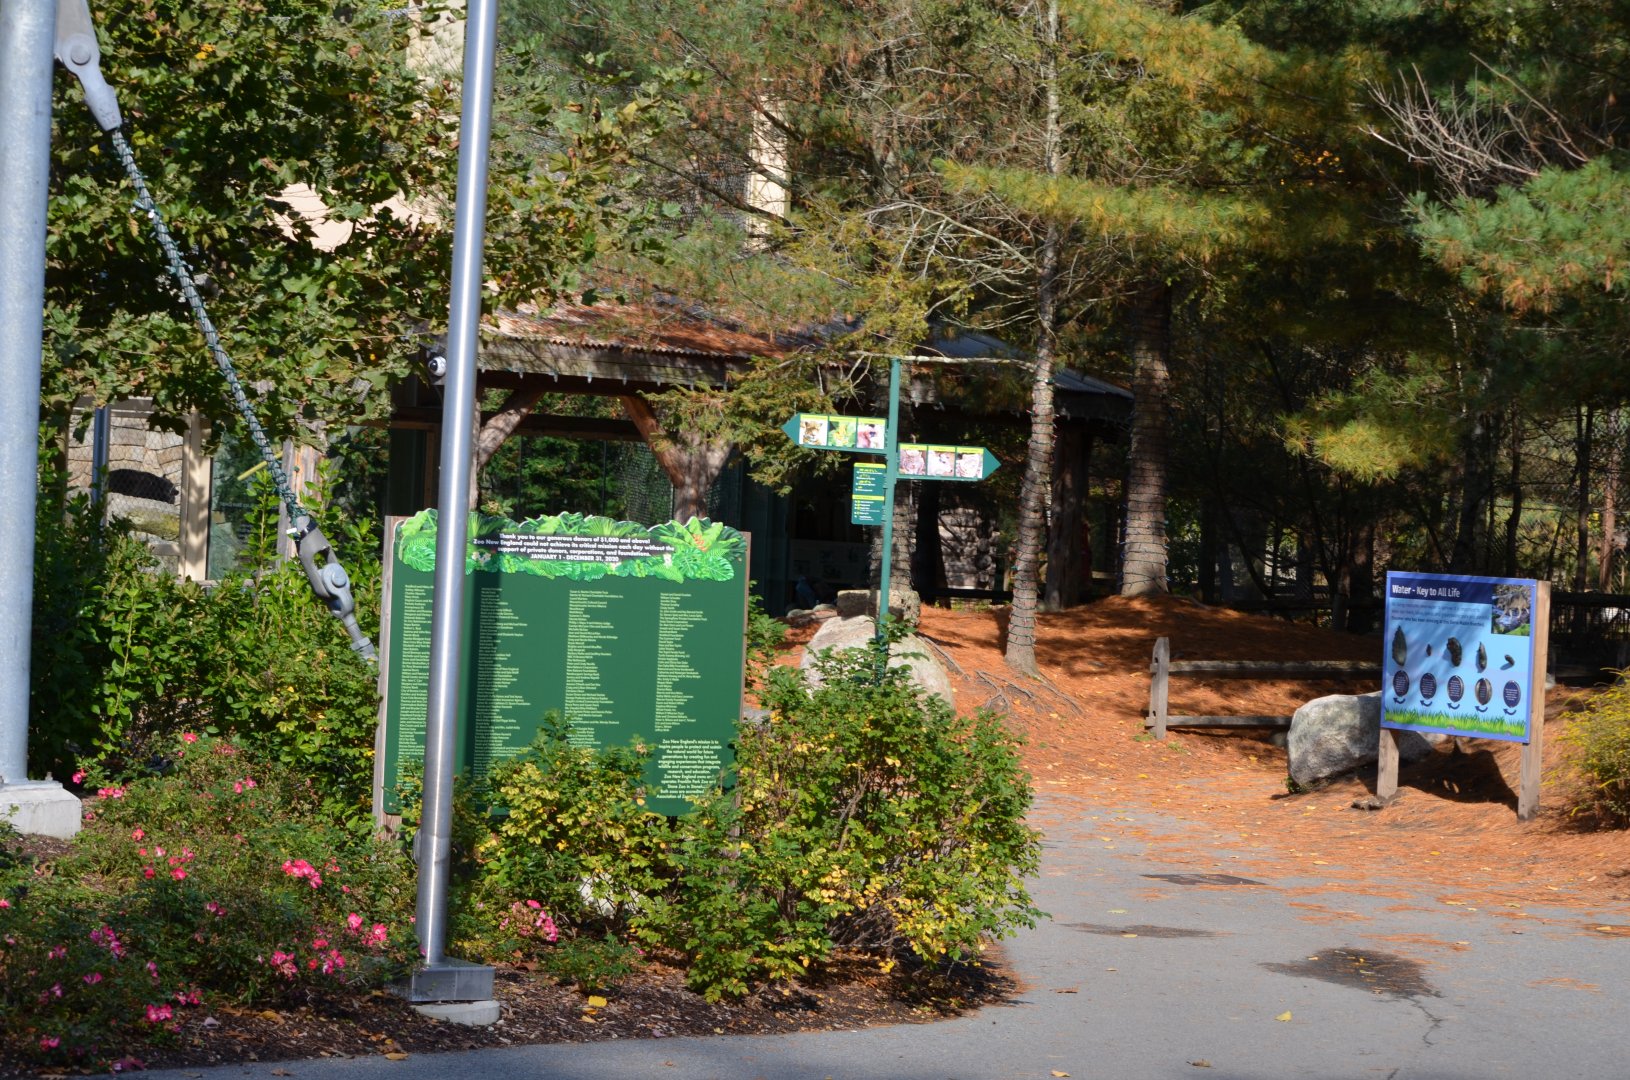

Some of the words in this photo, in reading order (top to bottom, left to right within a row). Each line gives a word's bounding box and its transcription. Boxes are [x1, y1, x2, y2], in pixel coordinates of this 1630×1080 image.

[1392, 585, 1411, 594] Water
[1416, 586, 1428, 597] Key
[1429, 588, 1437, 596] to
[1437, 588, 1447, 597] All
[1448, 588, 1460, 598] Life
